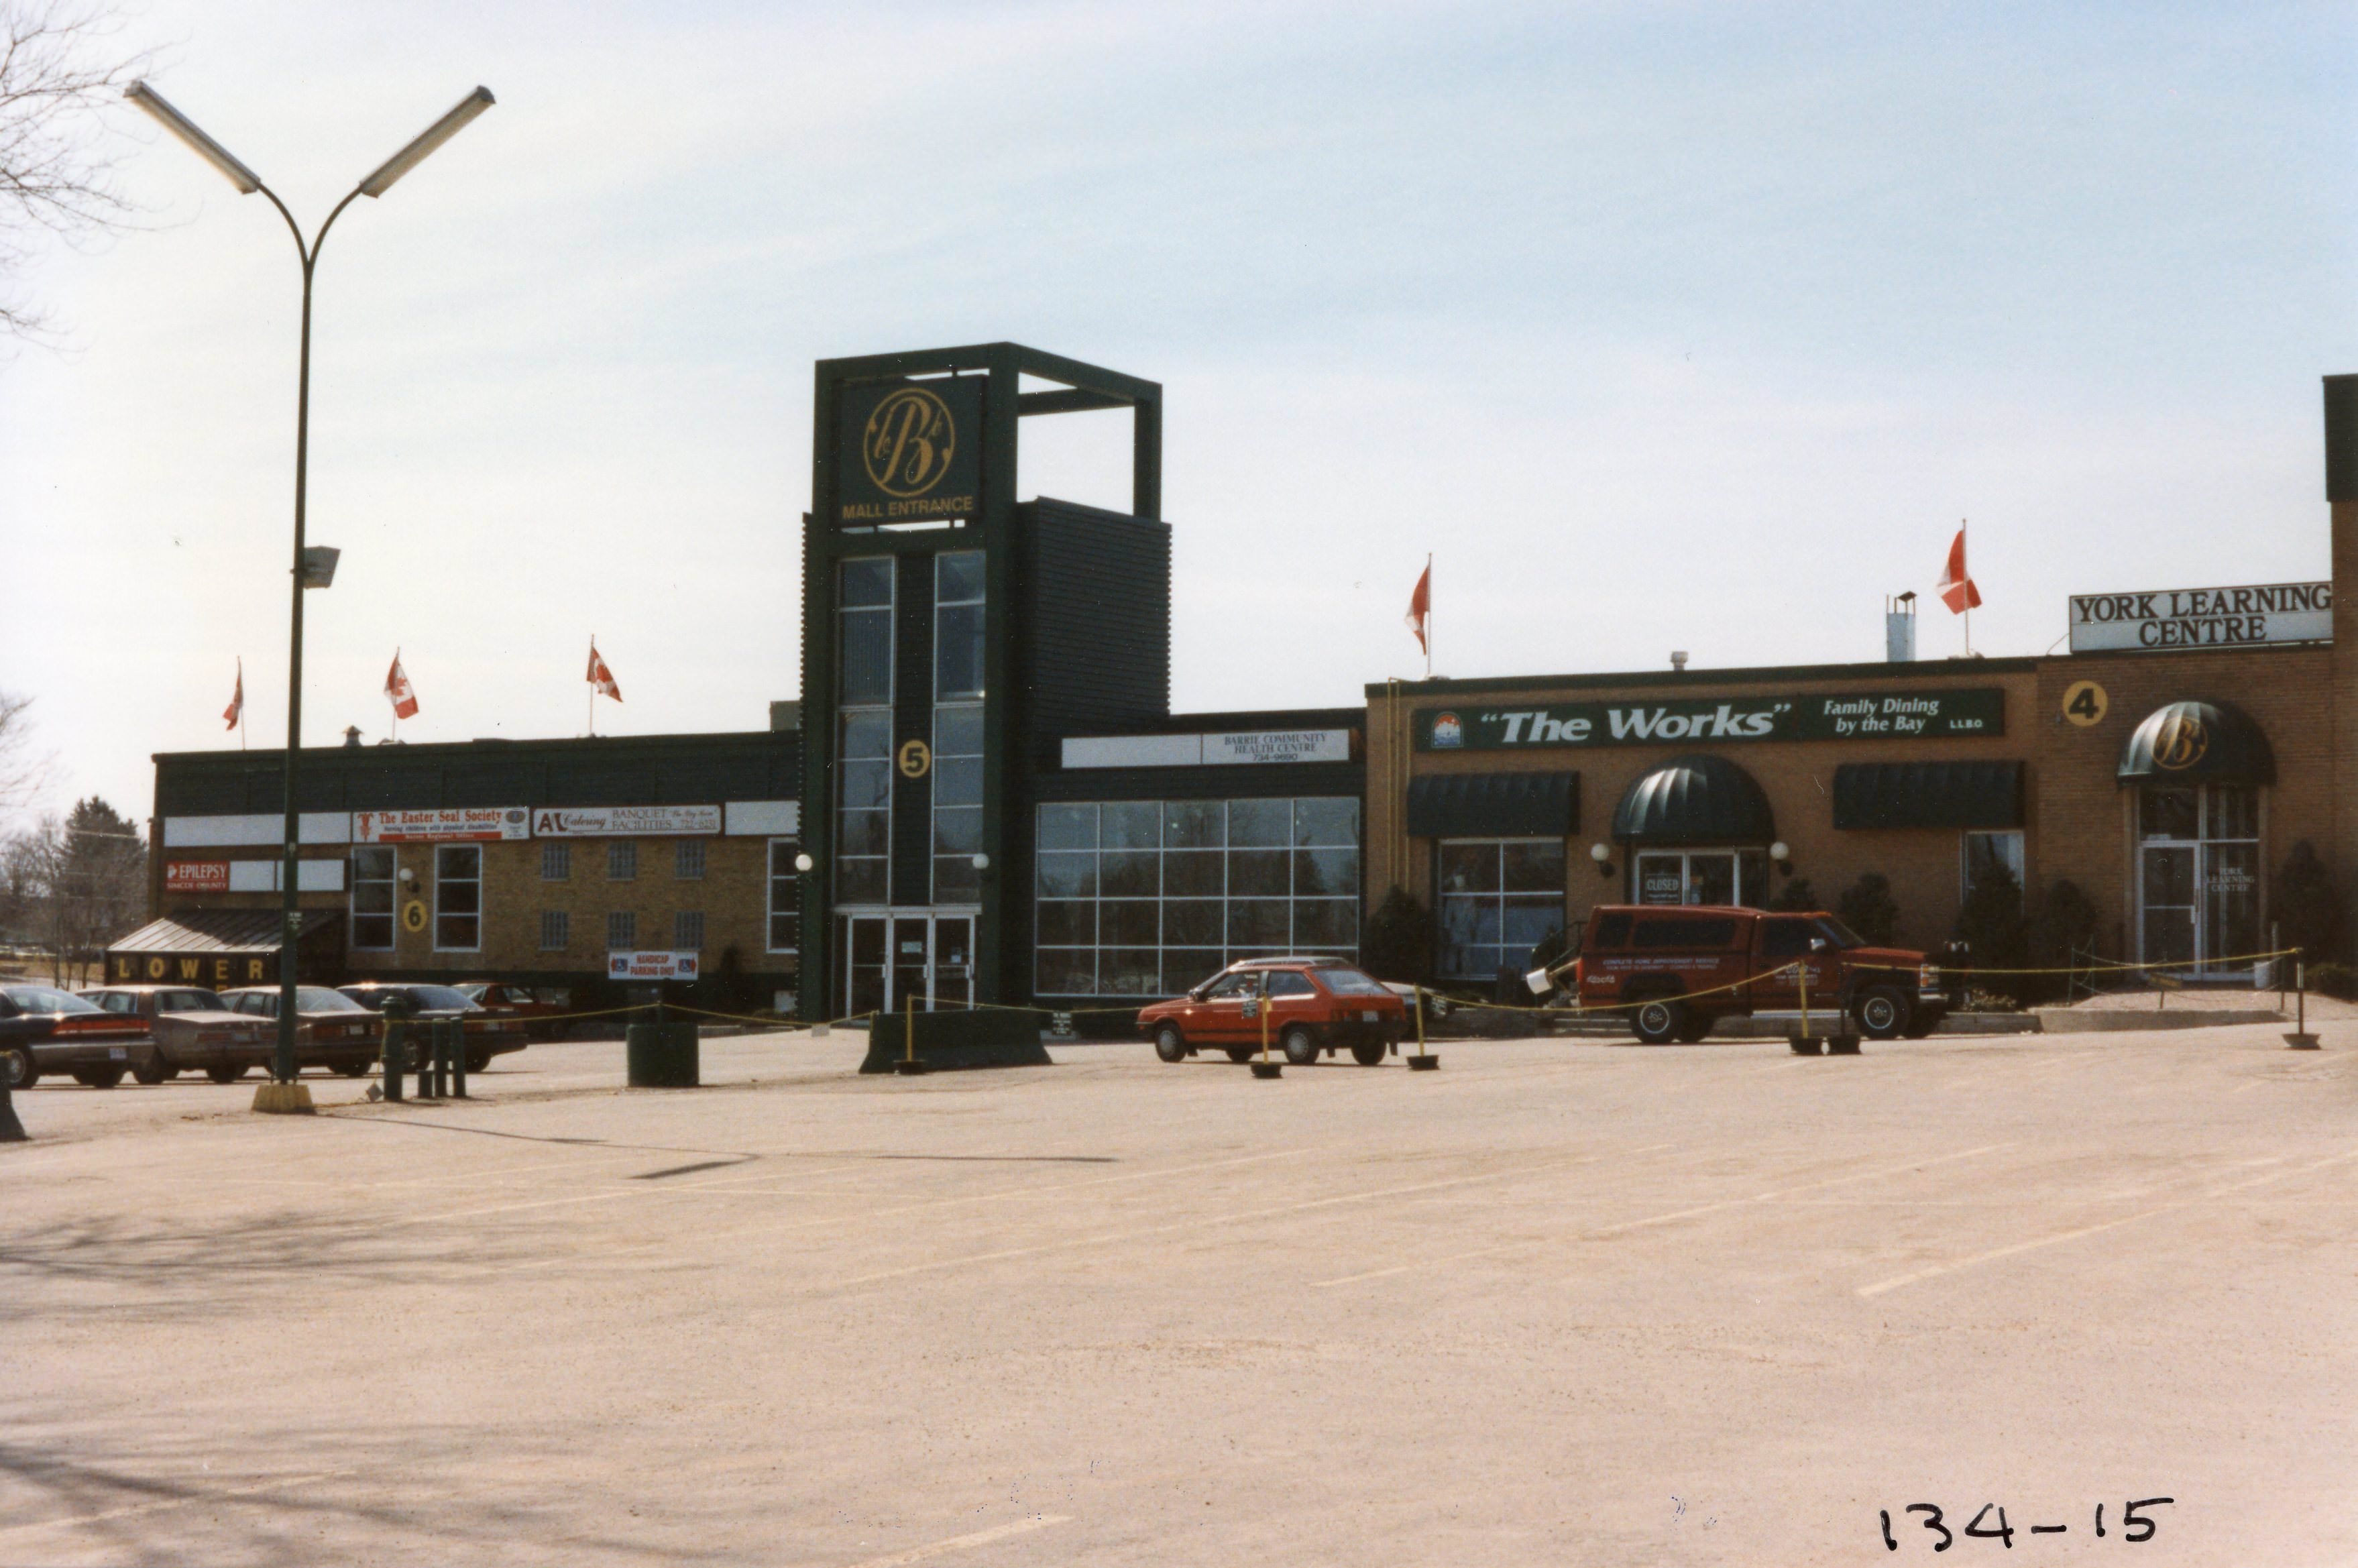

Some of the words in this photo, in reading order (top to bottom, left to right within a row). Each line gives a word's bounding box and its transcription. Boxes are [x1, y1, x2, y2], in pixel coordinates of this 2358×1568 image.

[842, 504, 884, 520] MALL
[888, 496, 973, 516] ENTRANCE
[2074, 594, 2159, 622] YORK
[2169, 583, 2332, 617] LEARNING
[2139, 616, 2267, 647] CENTRE
[1823, 698, 1878, 718] Family
[1883, 698, 1940, 716] Dining
[2068, 688, 2100, 720] 4
[1835, 717, 1857, 736] by
[1861, 716, 1890, 732] the
[1894, 716, 1926, 734] Bay
[1225, 735, 1258, 746] BARRIE
[1264, 733, 1327, 744] COMMUNITY
[1235, 744, 1274, 754] HEALTH
[1278, 742, 1316, 752] CENTRE
[905, 746, 924, 773] 5
[378, 812, 396, 824] The
[401, 811, 434, 824] Easter
[439, 809, 459, 822] Seal
[465, 809, 502, 824] Society
[612, 809, 668, 820] BANQUET
[612, 819, 672, 830] FACILITIES
[179, 864, 227, 879] EPILEPSY
[1646, 879, 1679, 891] CLOSED
[408, 905, 422, 927] 6
[118, 957, 264, 980] LOWER
[630, 966, 658, 976] PARKING
